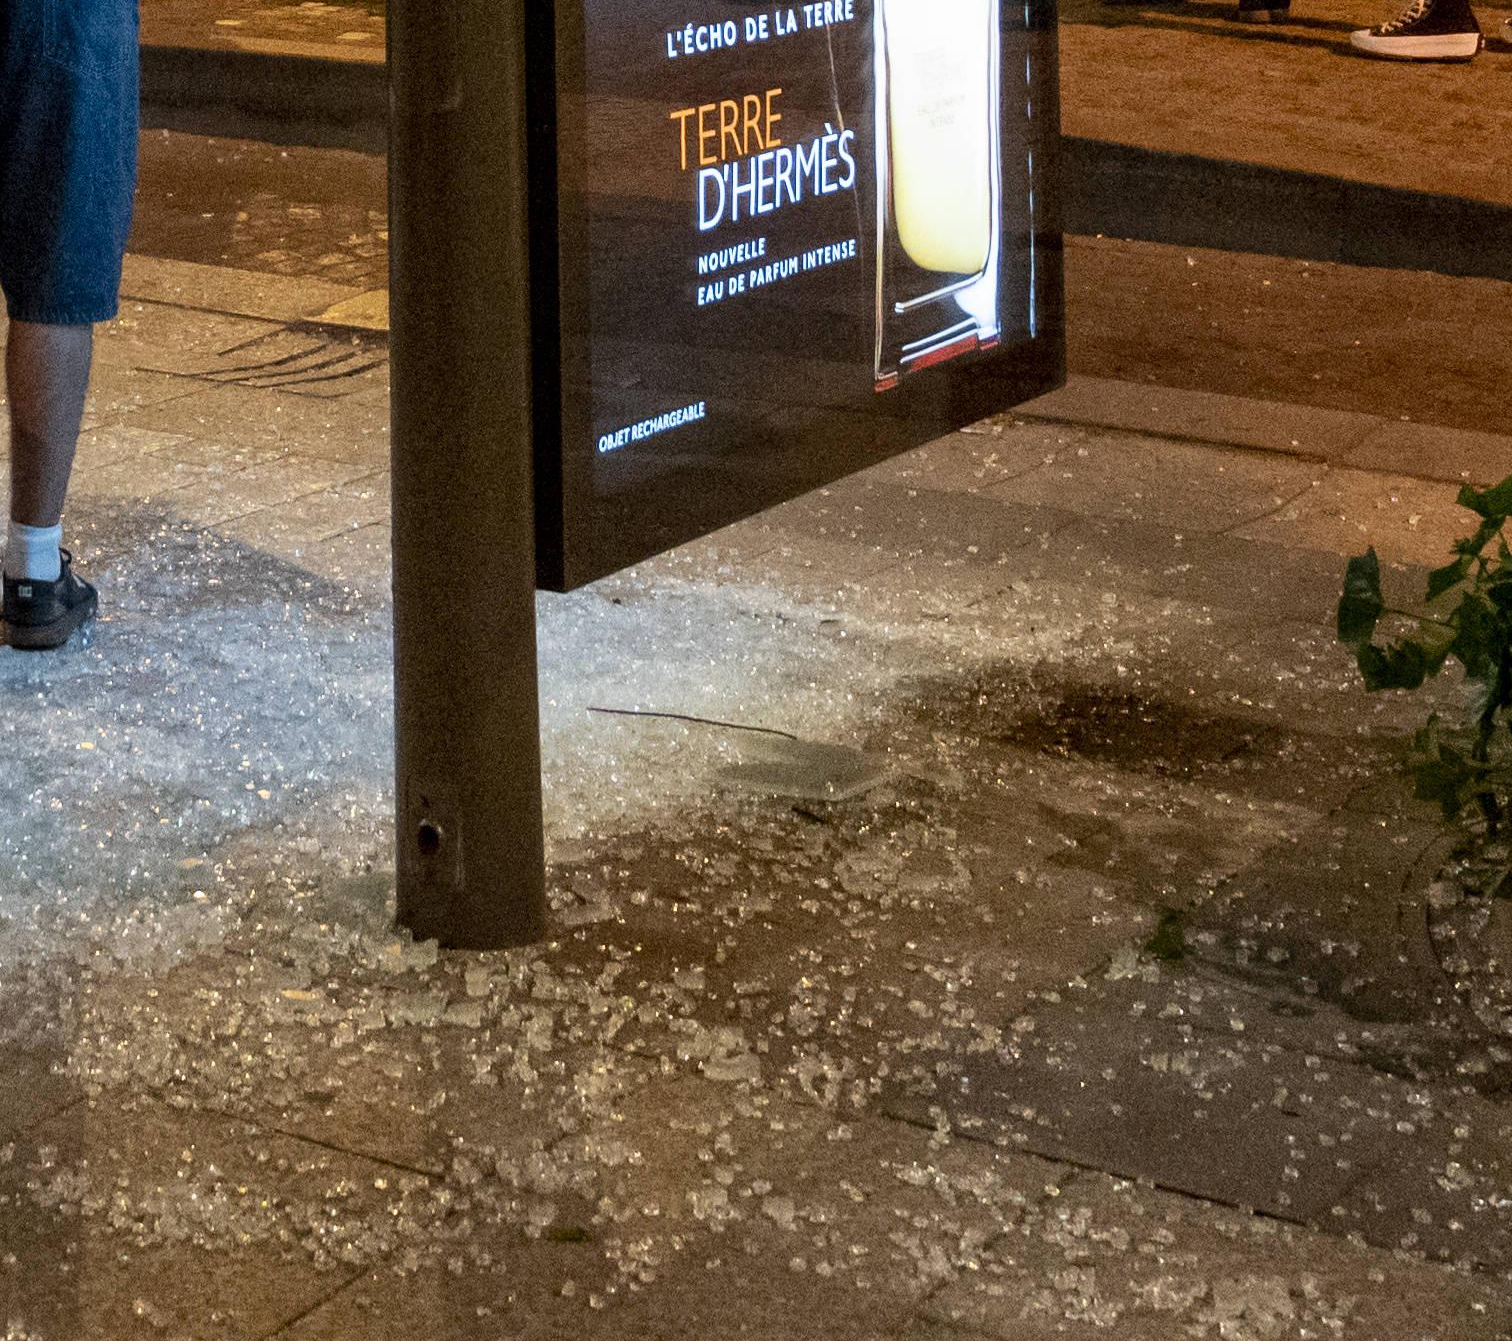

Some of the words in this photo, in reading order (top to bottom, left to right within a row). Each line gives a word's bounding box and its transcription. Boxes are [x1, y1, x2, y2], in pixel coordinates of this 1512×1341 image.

[667, 20, 737, 58] L'ÉCHO
[745, 12, 769, 42] DE
[775, 7, 798, 35] LA
[670, 88, 783, 170] TERRE
[698, 123, 856, 230] D'HERMÈS
[698, 237, 766, 274] NOUVELLE
[698, 280, 725, 306] EAU
[729, 275, 746, 297] DE
[750, 258, 799, 288] PARFUM
[802, 239, 856, 270] INTENSE
[598, 426, 630, 454] OBJET
[631, 402, 706, 444] RECHARGEABLE
